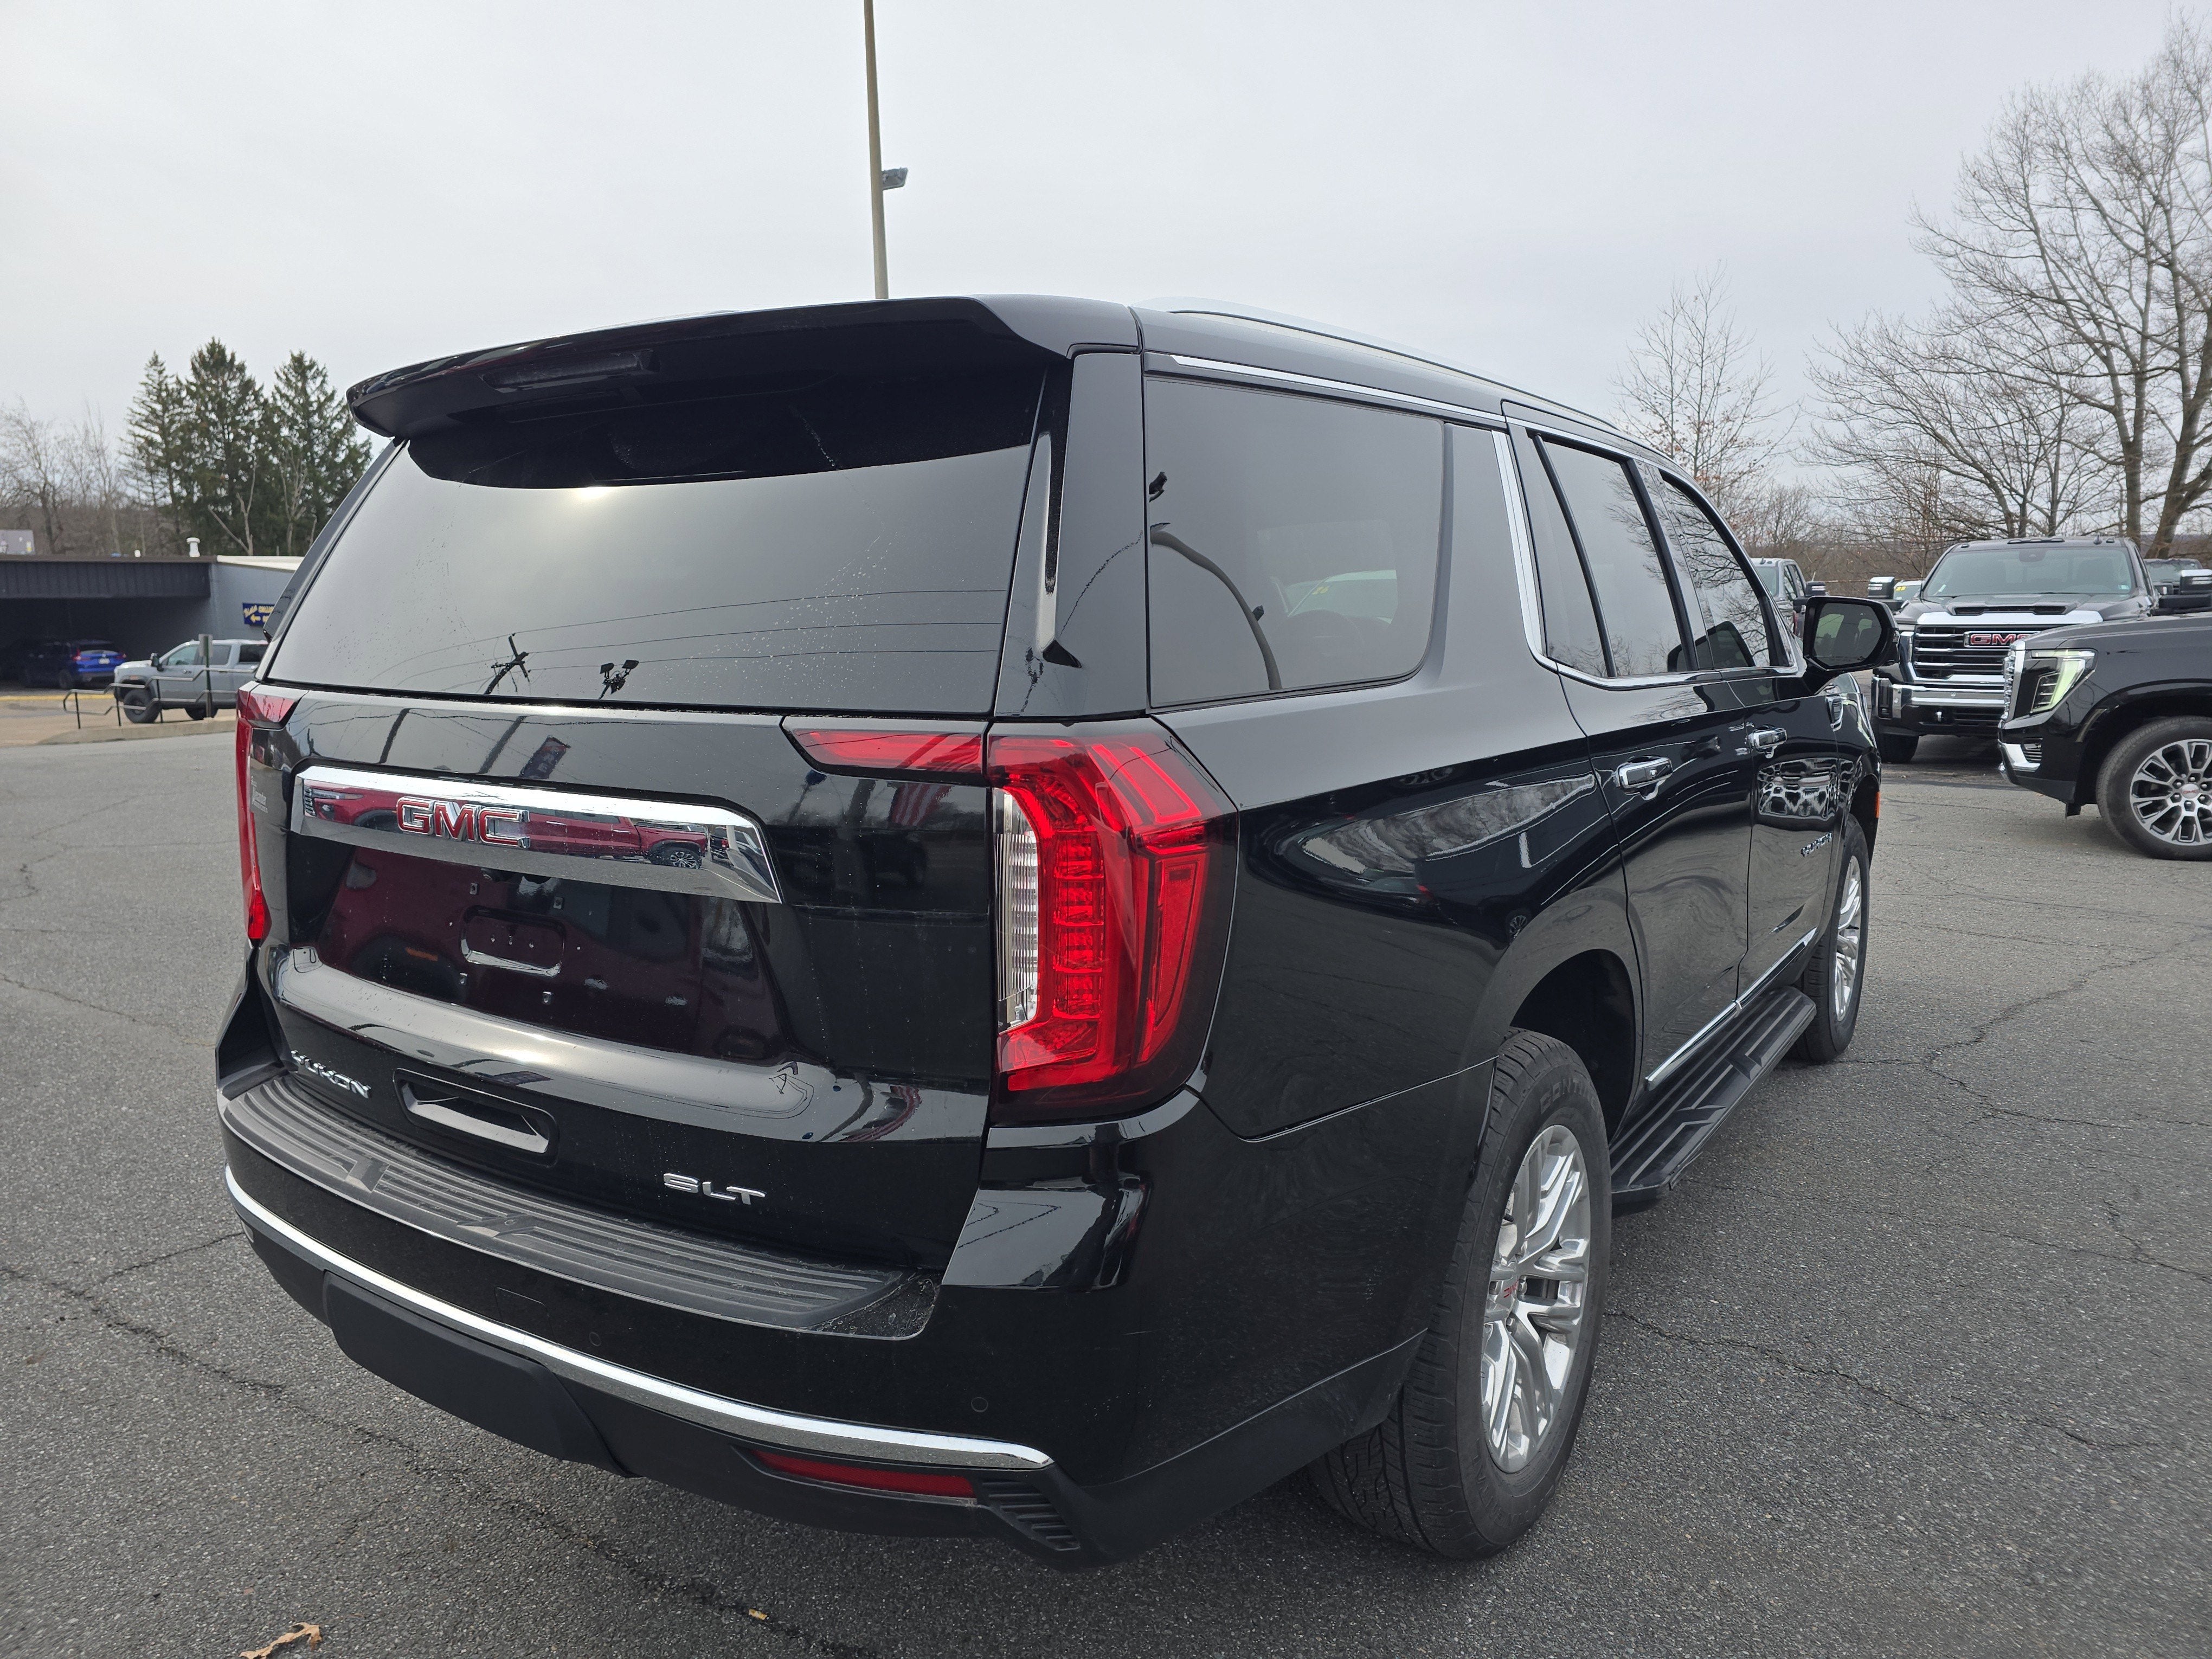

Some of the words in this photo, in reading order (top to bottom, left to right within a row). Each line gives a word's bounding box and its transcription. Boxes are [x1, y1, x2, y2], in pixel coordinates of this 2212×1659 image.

[396, 796, 530, 849] GMC
[291, 1050, 371, 1099] YUKON
[663, 1173, 767, 1205] SLT
